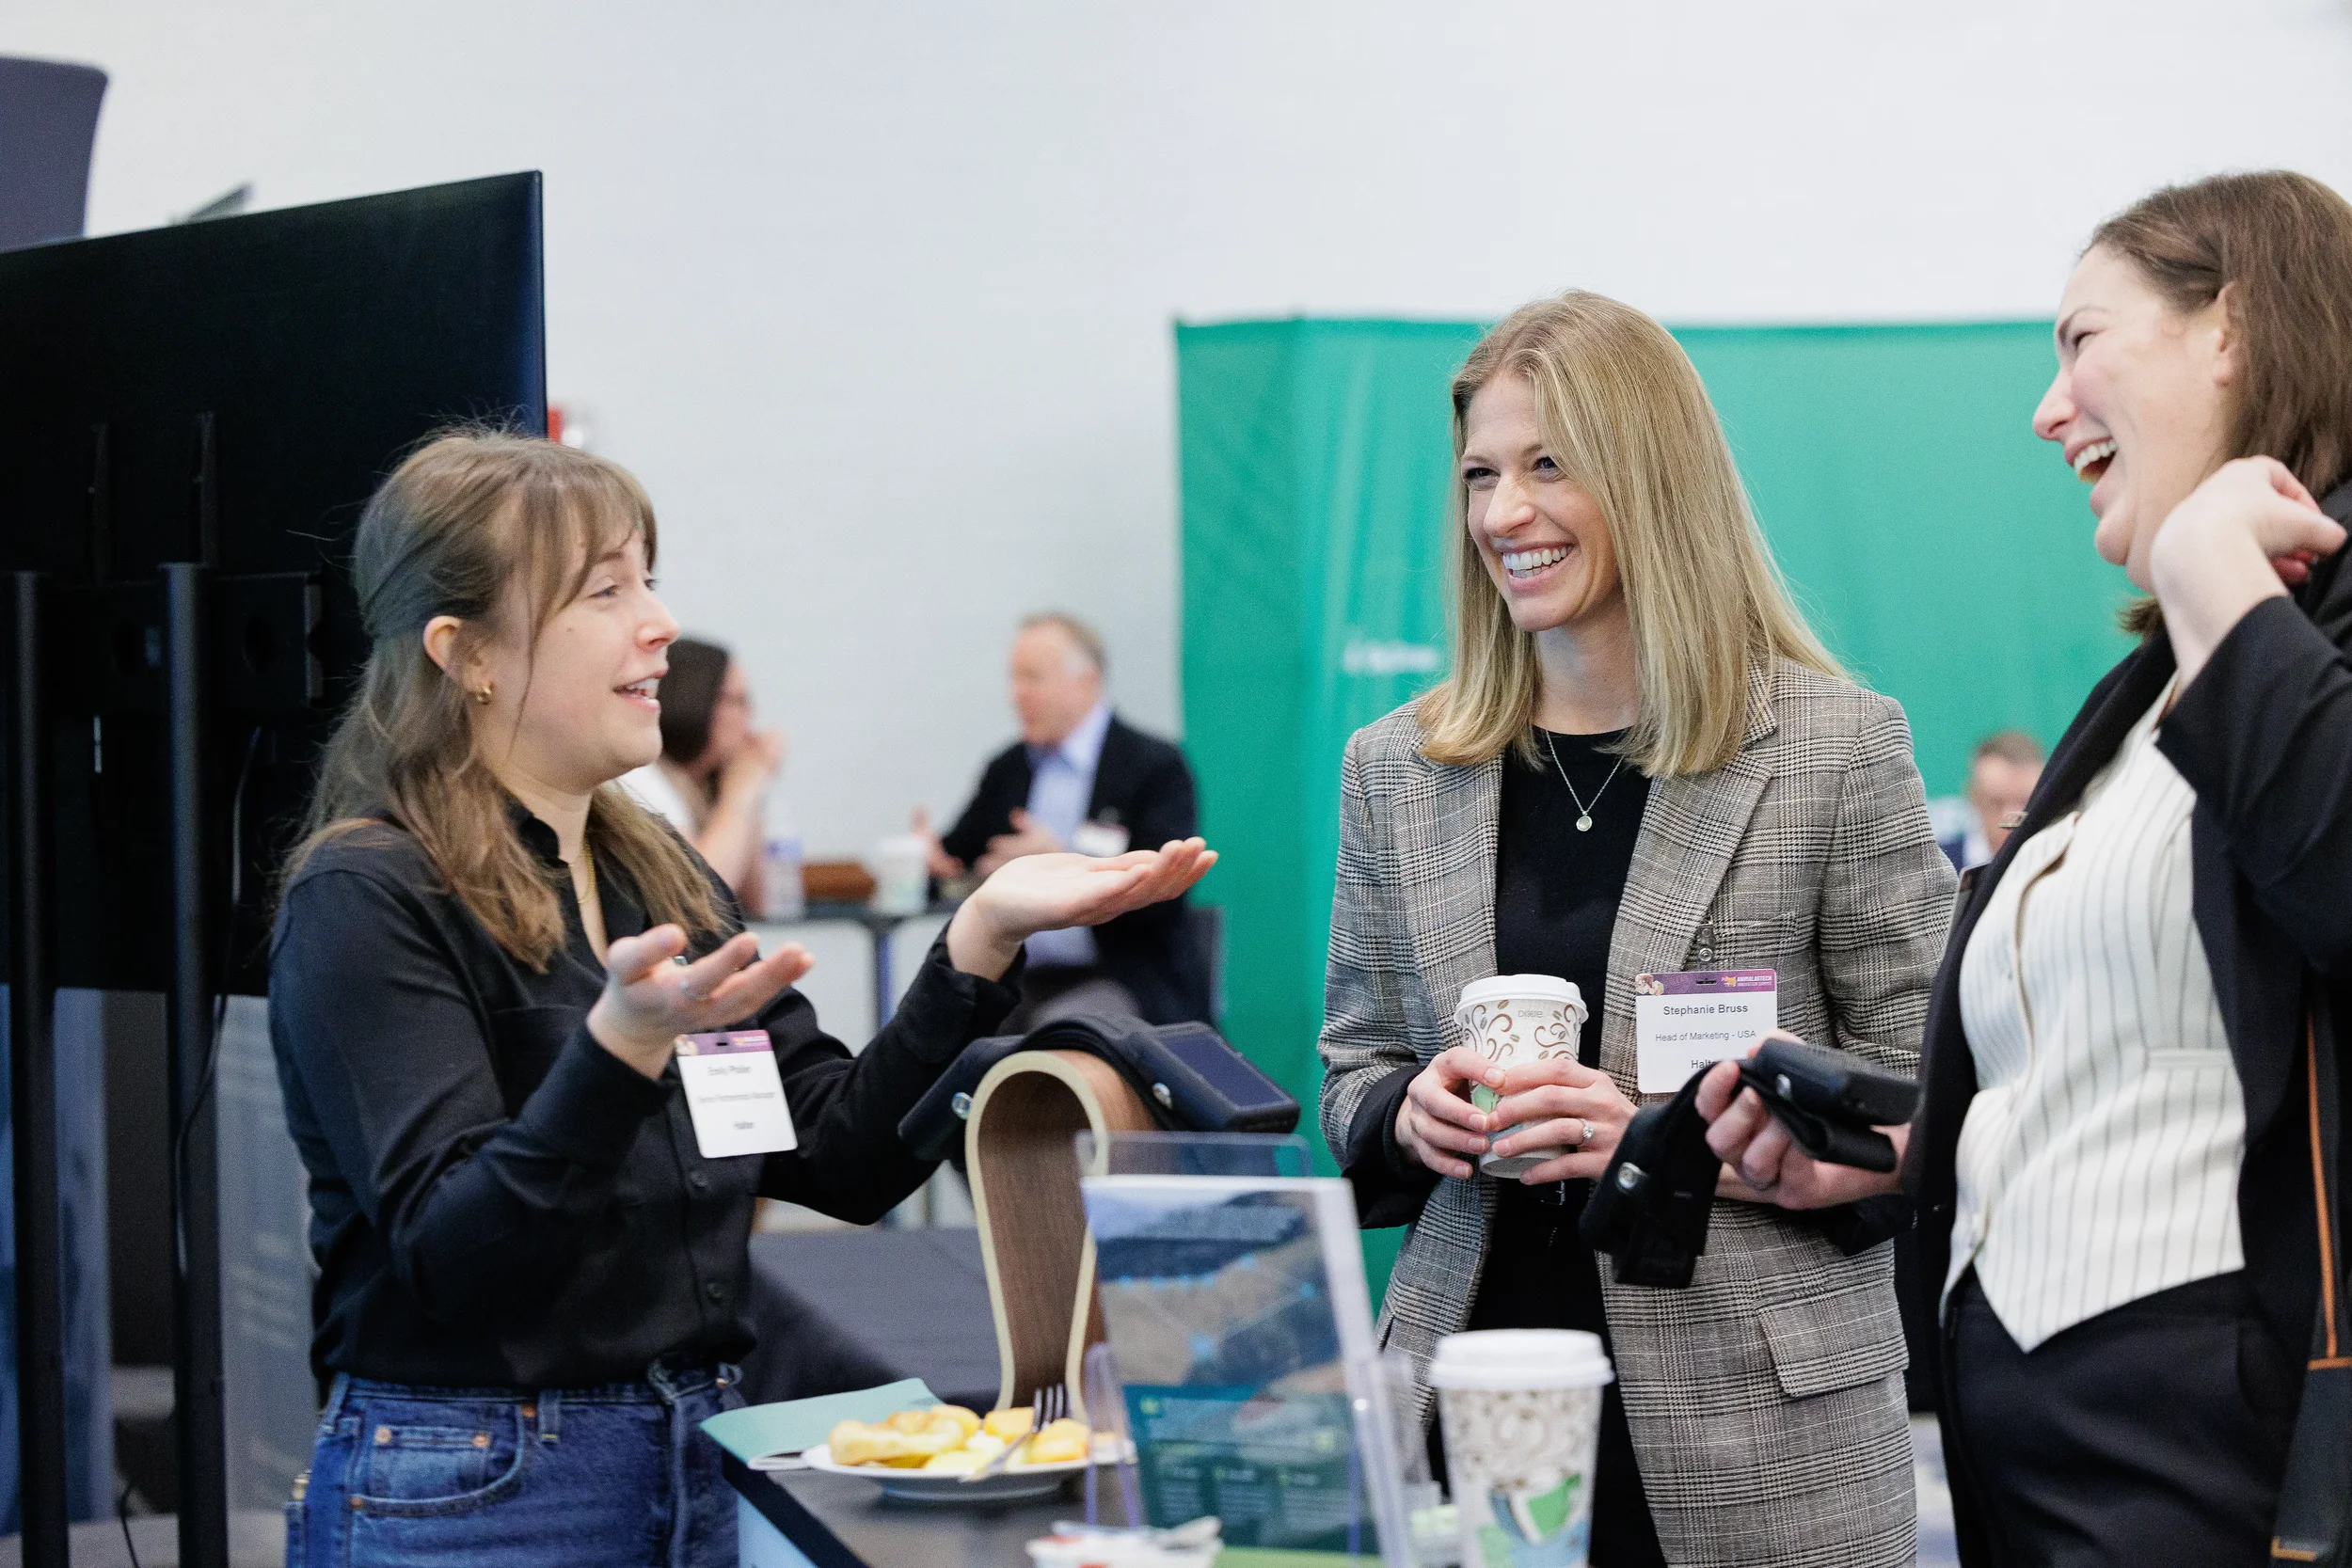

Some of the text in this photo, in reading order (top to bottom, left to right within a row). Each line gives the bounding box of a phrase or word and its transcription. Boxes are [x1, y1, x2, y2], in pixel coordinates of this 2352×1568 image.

[1663, 1004, 1748, 1016] Stephanie Bruss
[1679, 1032, 1688, 1040] of
[1690, 1031, 1729, 1040] Marketing
